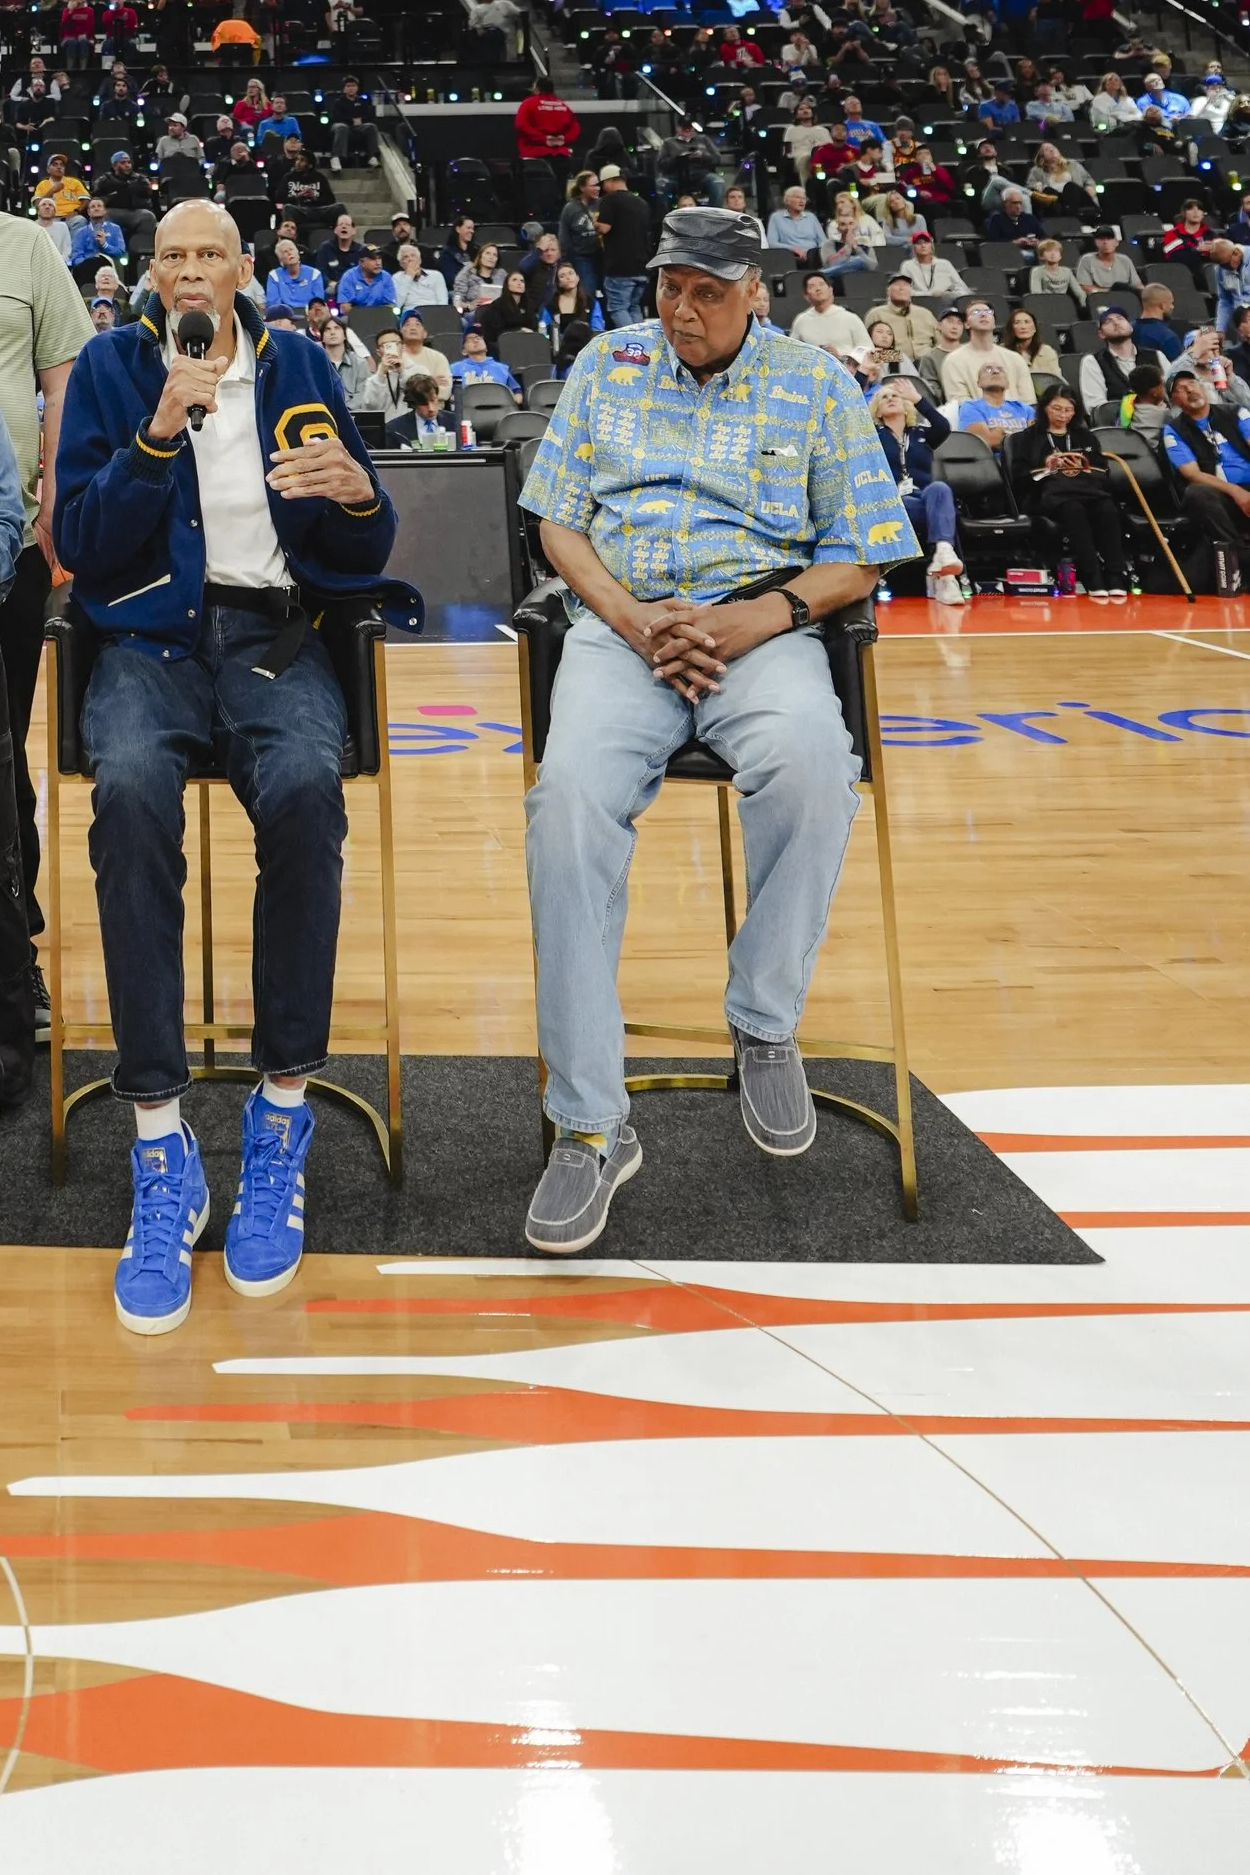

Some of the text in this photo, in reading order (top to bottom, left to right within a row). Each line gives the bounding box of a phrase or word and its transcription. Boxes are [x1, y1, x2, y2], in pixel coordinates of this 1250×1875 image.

[854, 469, 891, 488] UCLA
[761, 501, 800, 518] UCLA
[265, 1113, 291, 1125] adidas
